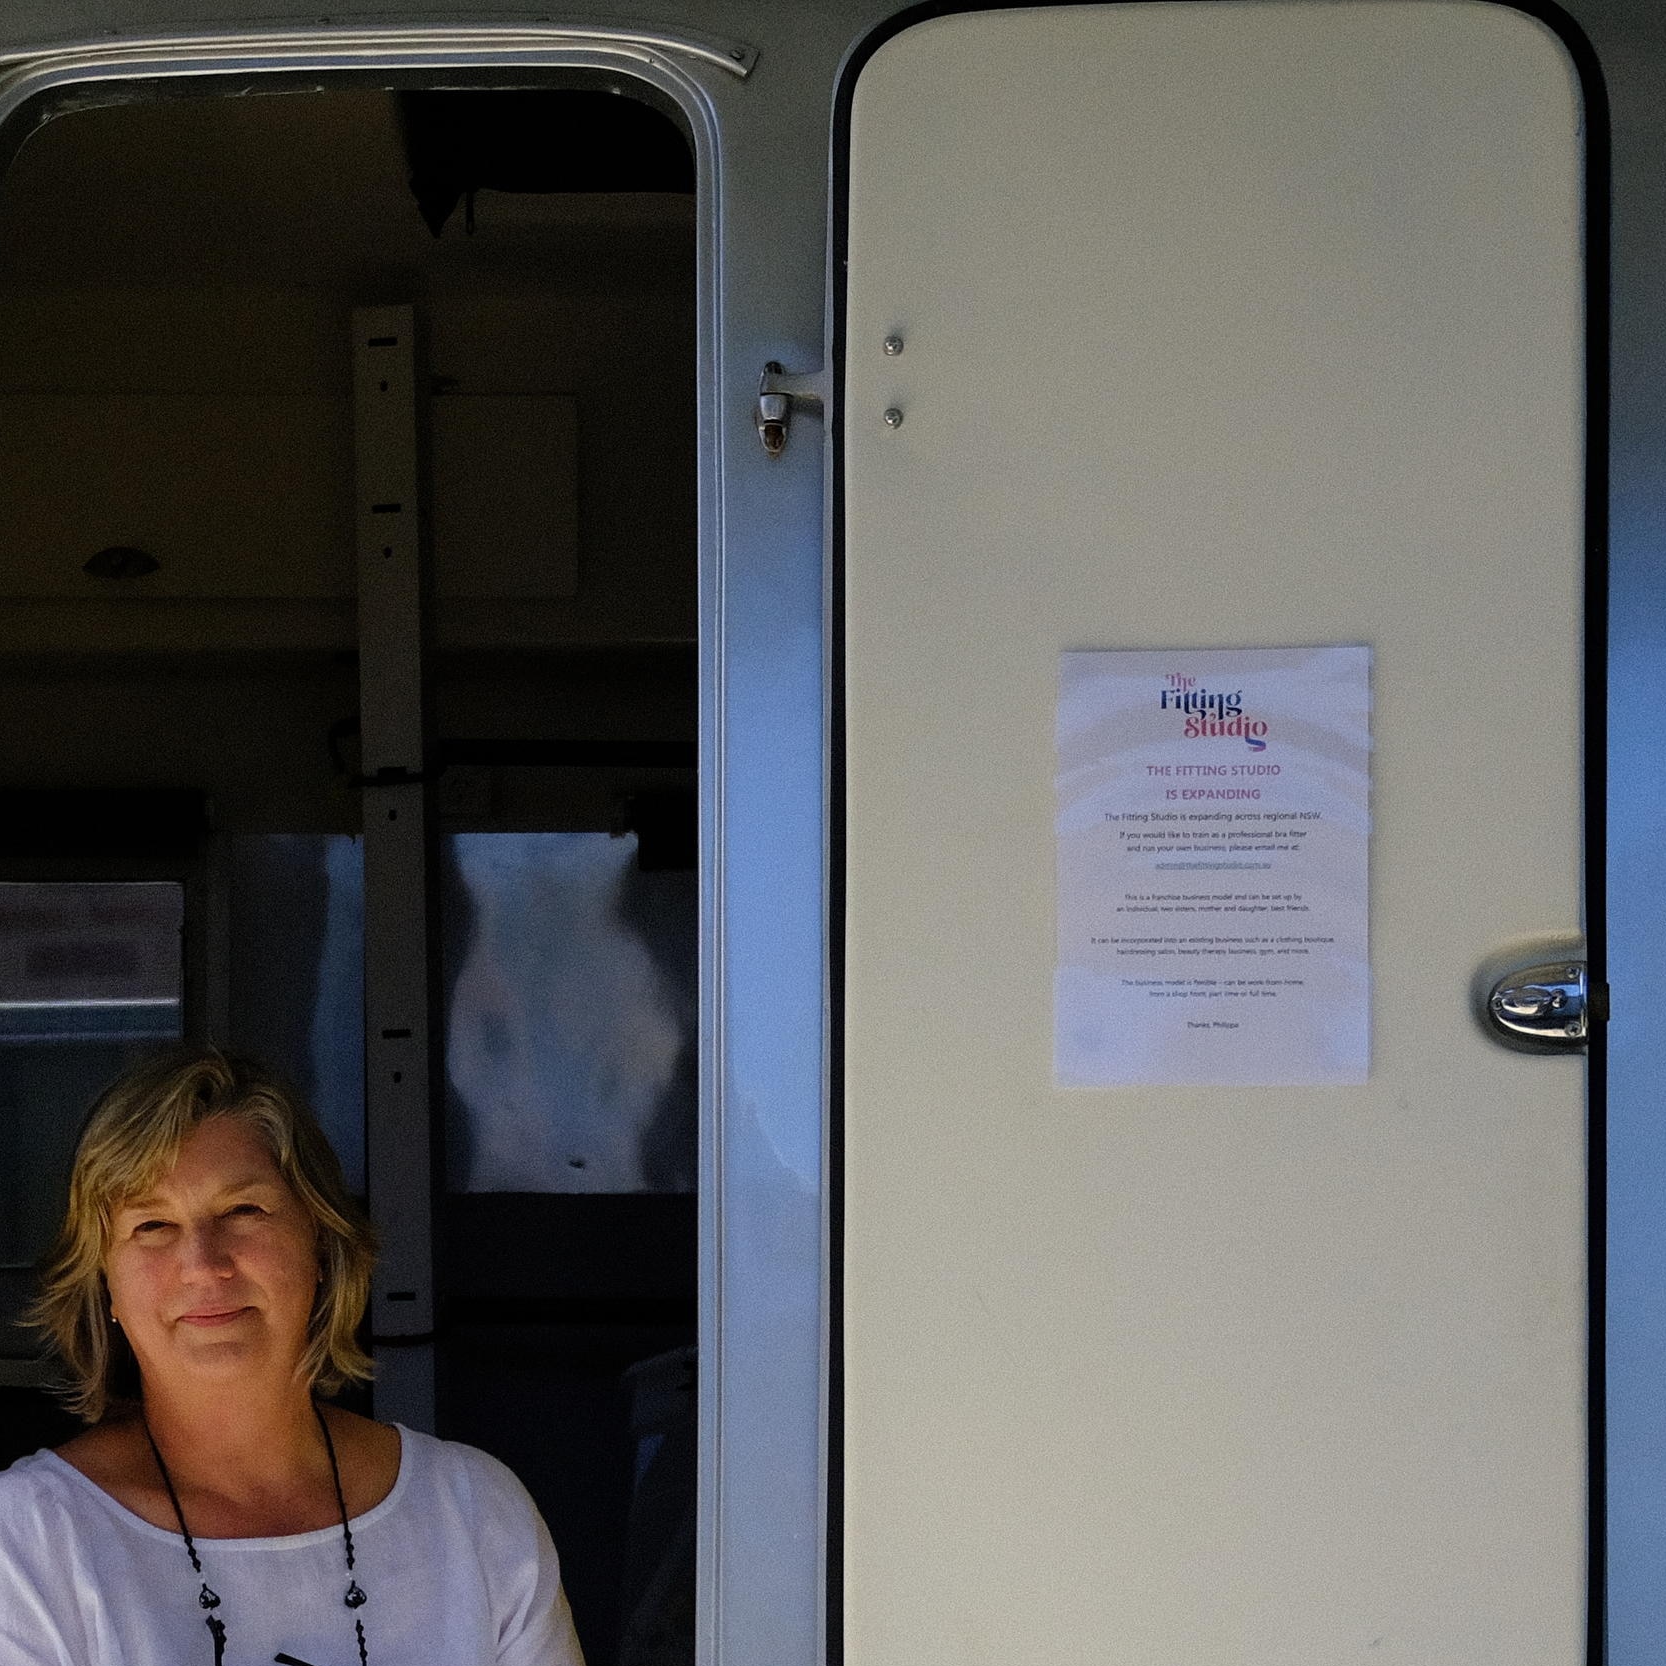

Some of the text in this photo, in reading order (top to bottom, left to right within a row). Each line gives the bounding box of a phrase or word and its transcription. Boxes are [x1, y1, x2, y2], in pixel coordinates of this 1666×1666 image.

[1166, 672, 1196, 691] The
[1161, 688, 1242, 720] Fitting
[1184, 712, 1268, 752] Studio
[1146, 764, 1281, 776] THE FITTING STUDIO
[1165, 789, 1261, 800] IS EXPANDING
[1122, 812, 1148, 823] Fitting
[1151, 812, 1178, 821] Studio
[1189, 812, 1232, 822] expanding
[1263, 812, 1297, 821] regional
[1228, 831, 1272, 839] professional
